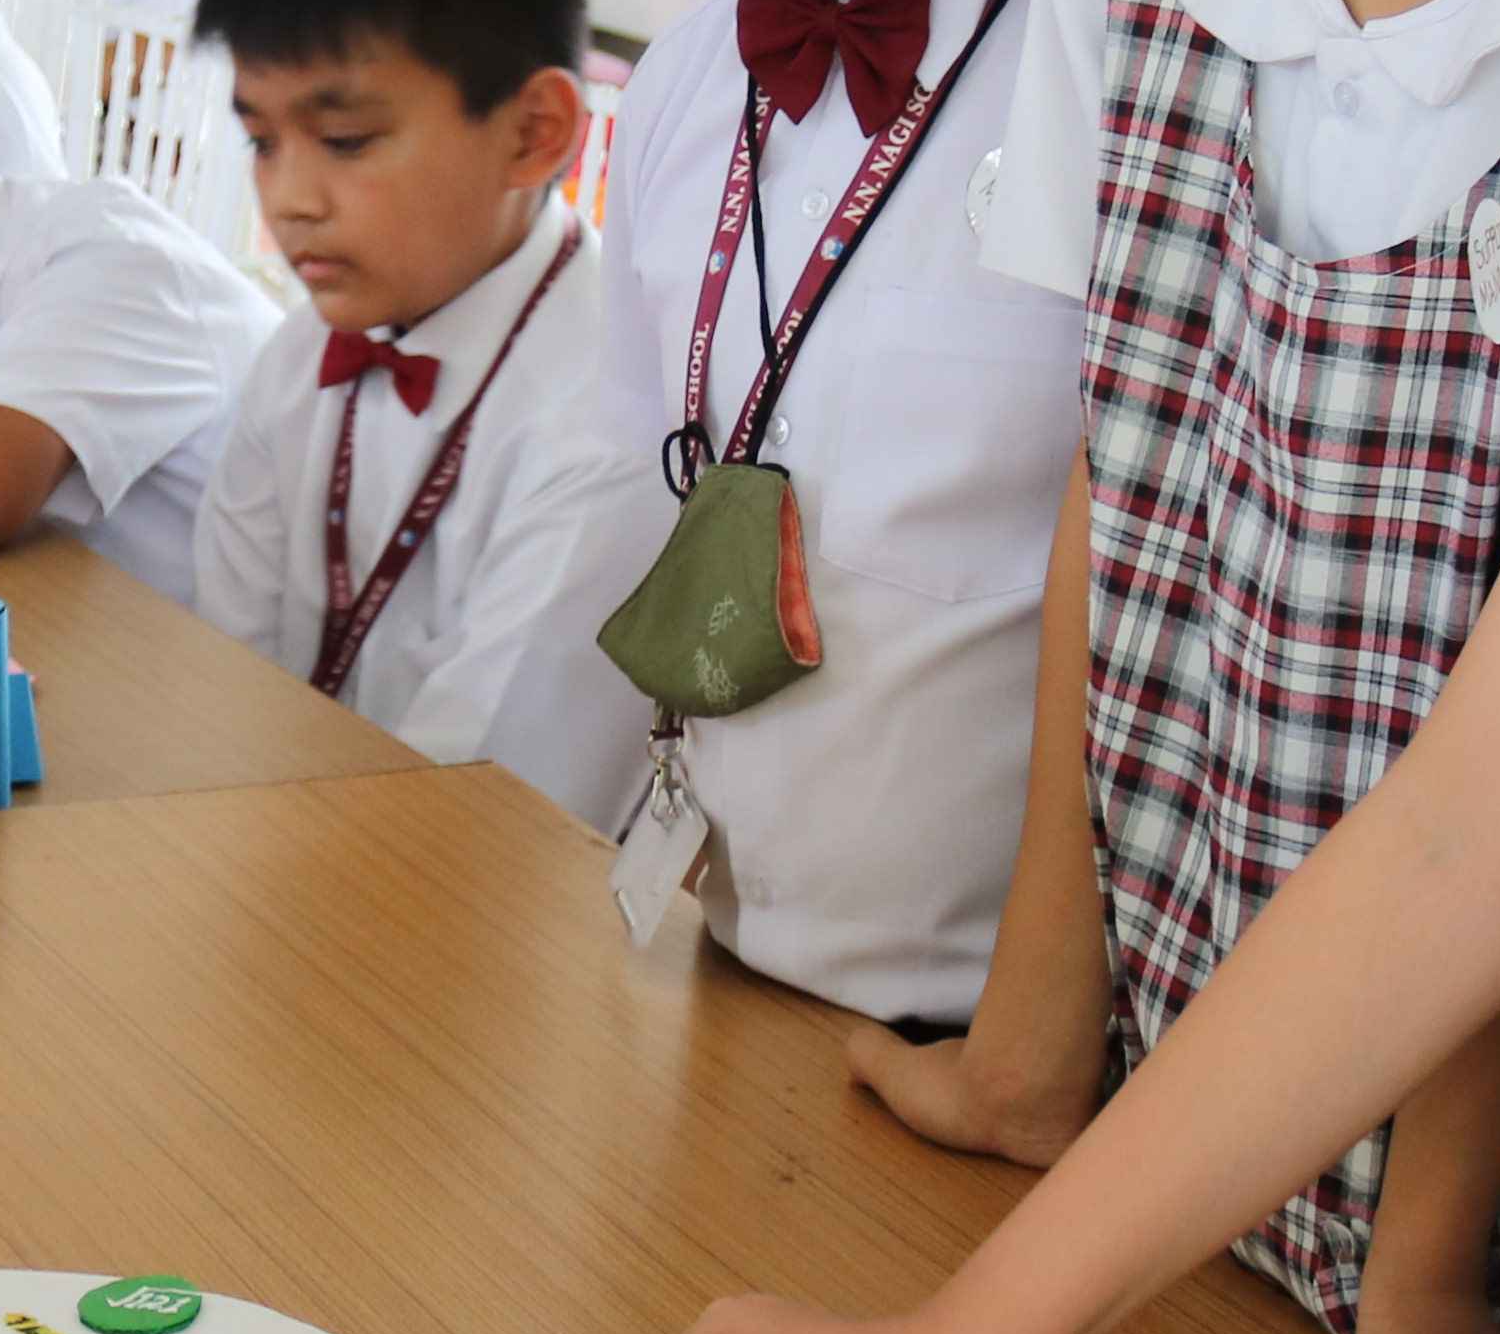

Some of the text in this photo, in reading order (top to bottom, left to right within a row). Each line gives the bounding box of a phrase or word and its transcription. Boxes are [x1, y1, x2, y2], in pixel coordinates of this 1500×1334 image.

[721, 186, 746, 234] N.N.
[842, 120, 918, 226] N.N. NAGI
